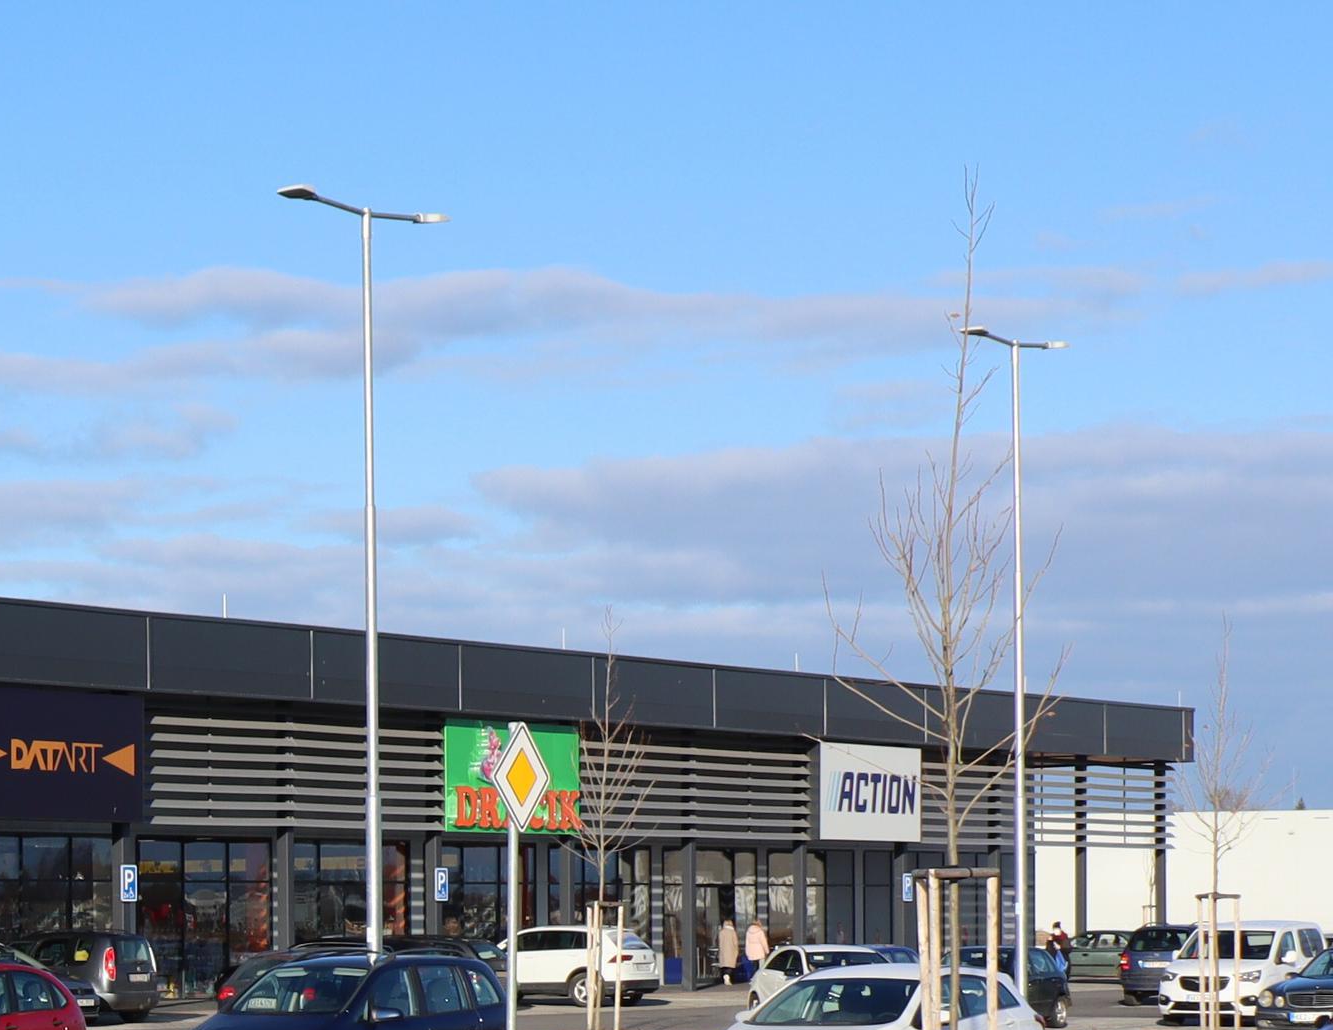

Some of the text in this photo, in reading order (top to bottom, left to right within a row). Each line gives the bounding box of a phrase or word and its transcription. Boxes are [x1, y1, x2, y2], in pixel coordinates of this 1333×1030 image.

[10, 738, 104, 774] DATART
[455, 785, 583, 831] DRIK
[838, 771, 917, 815] ACTION
[125, 869, 134, 890] P
[438, 871, 446, 891] P
